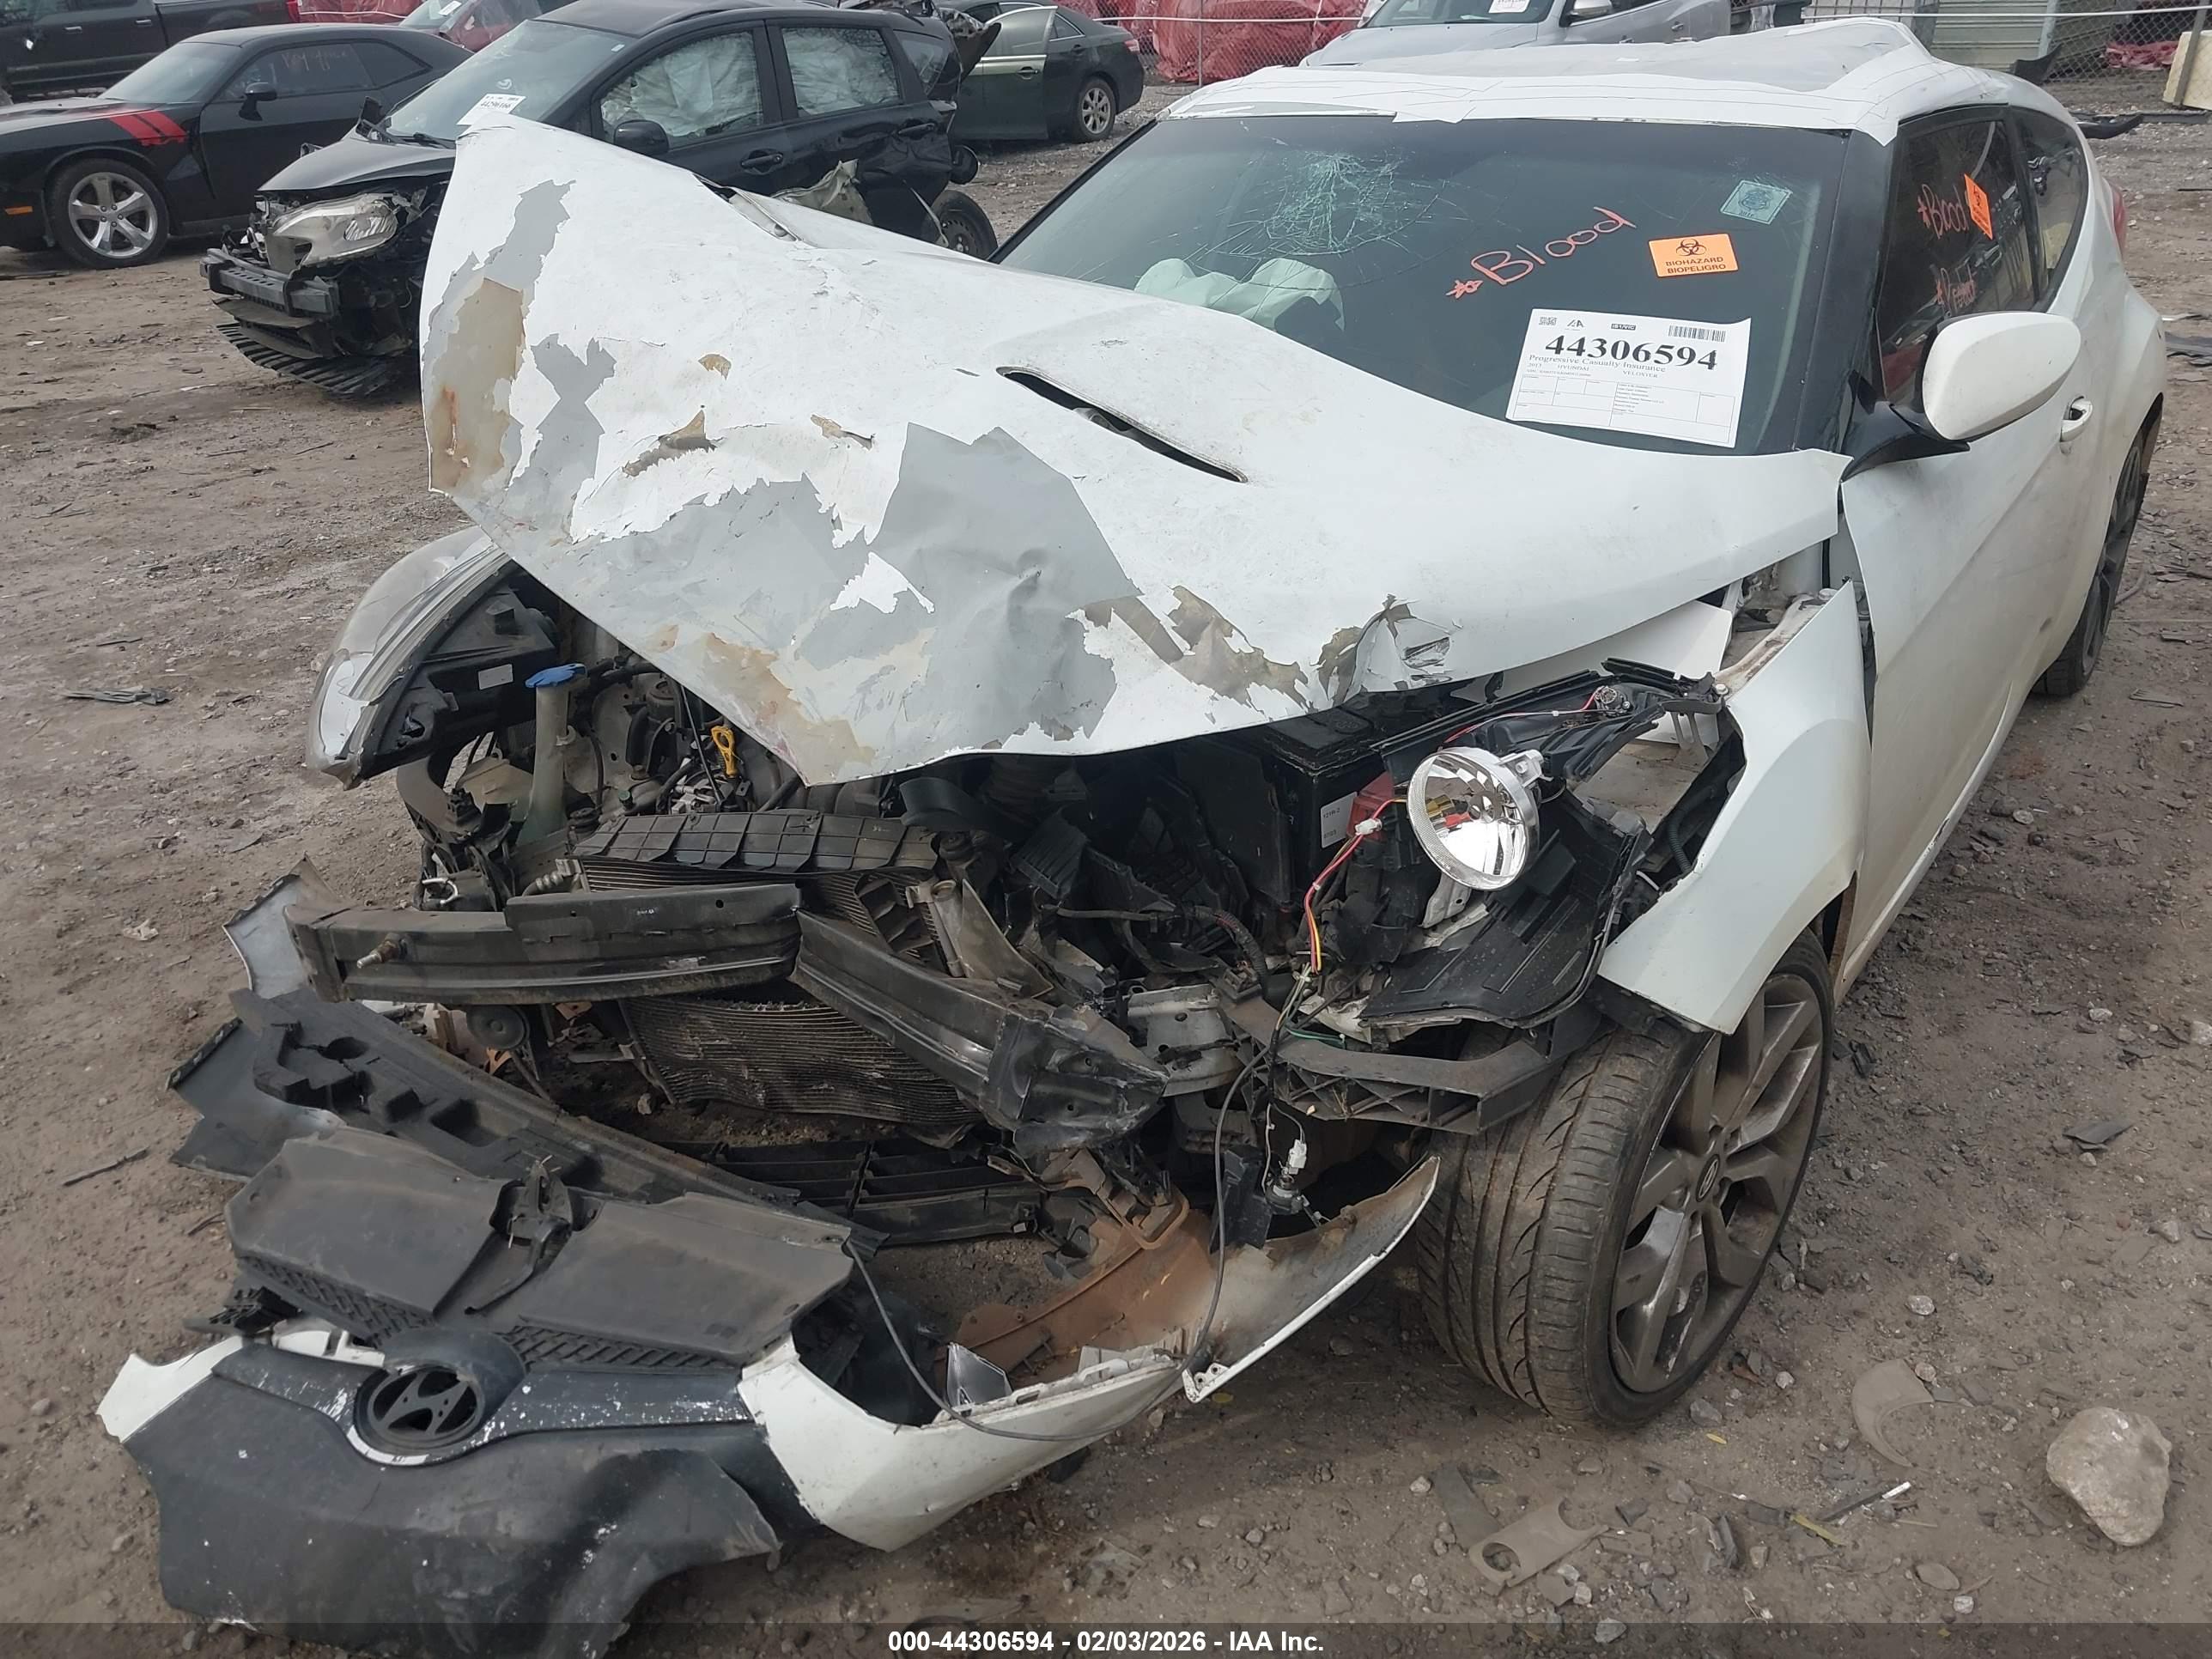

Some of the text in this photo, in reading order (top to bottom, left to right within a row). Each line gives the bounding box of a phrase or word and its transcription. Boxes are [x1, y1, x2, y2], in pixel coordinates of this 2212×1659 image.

[1665, 256, 1723, 267] BIOHAZARD
[1667, 264, 1726, 274] BIOPELIGRO
[1545, 335, 1718, 370] 44306594
[1529, 354, 1666, 373] Progressive Casualty Insurance
